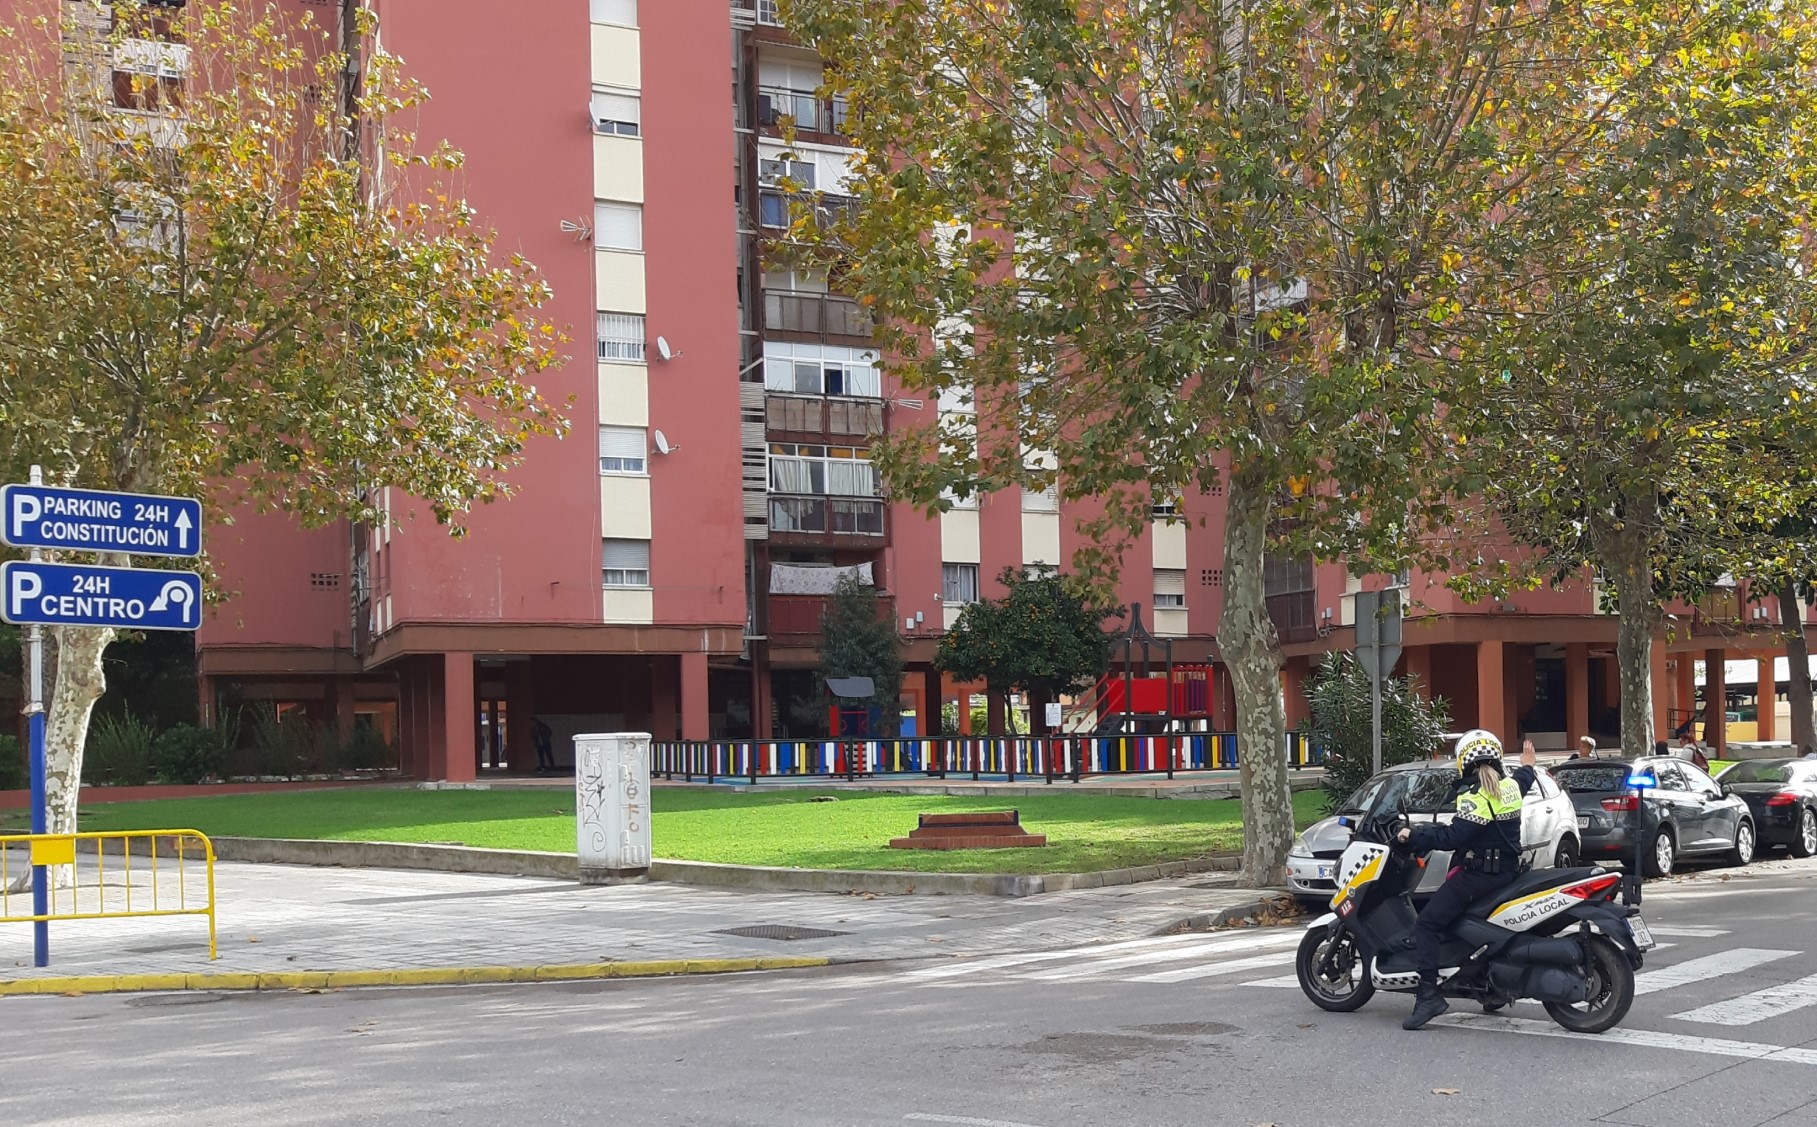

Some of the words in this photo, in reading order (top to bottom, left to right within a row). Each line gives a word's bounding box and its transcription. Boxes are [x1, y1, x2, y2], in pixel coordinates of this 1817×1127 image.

[13, 494, 41, 537] P
[44, 496, 121, 519] PARKING
[134, 504, 169, 523] 24H
[41, 521, 169, 546] CONSTITUCIÓN
[12, 571, 42, 615] P
[72, 575, 110, 594] 24H
[41, 595, 145, 619] CENTRO
[1502, 793, 1520, 804] LOCAL
[1503, 910, 1537, 926] POLICIA
[1538, 898, 1570, 915] LOCAL
